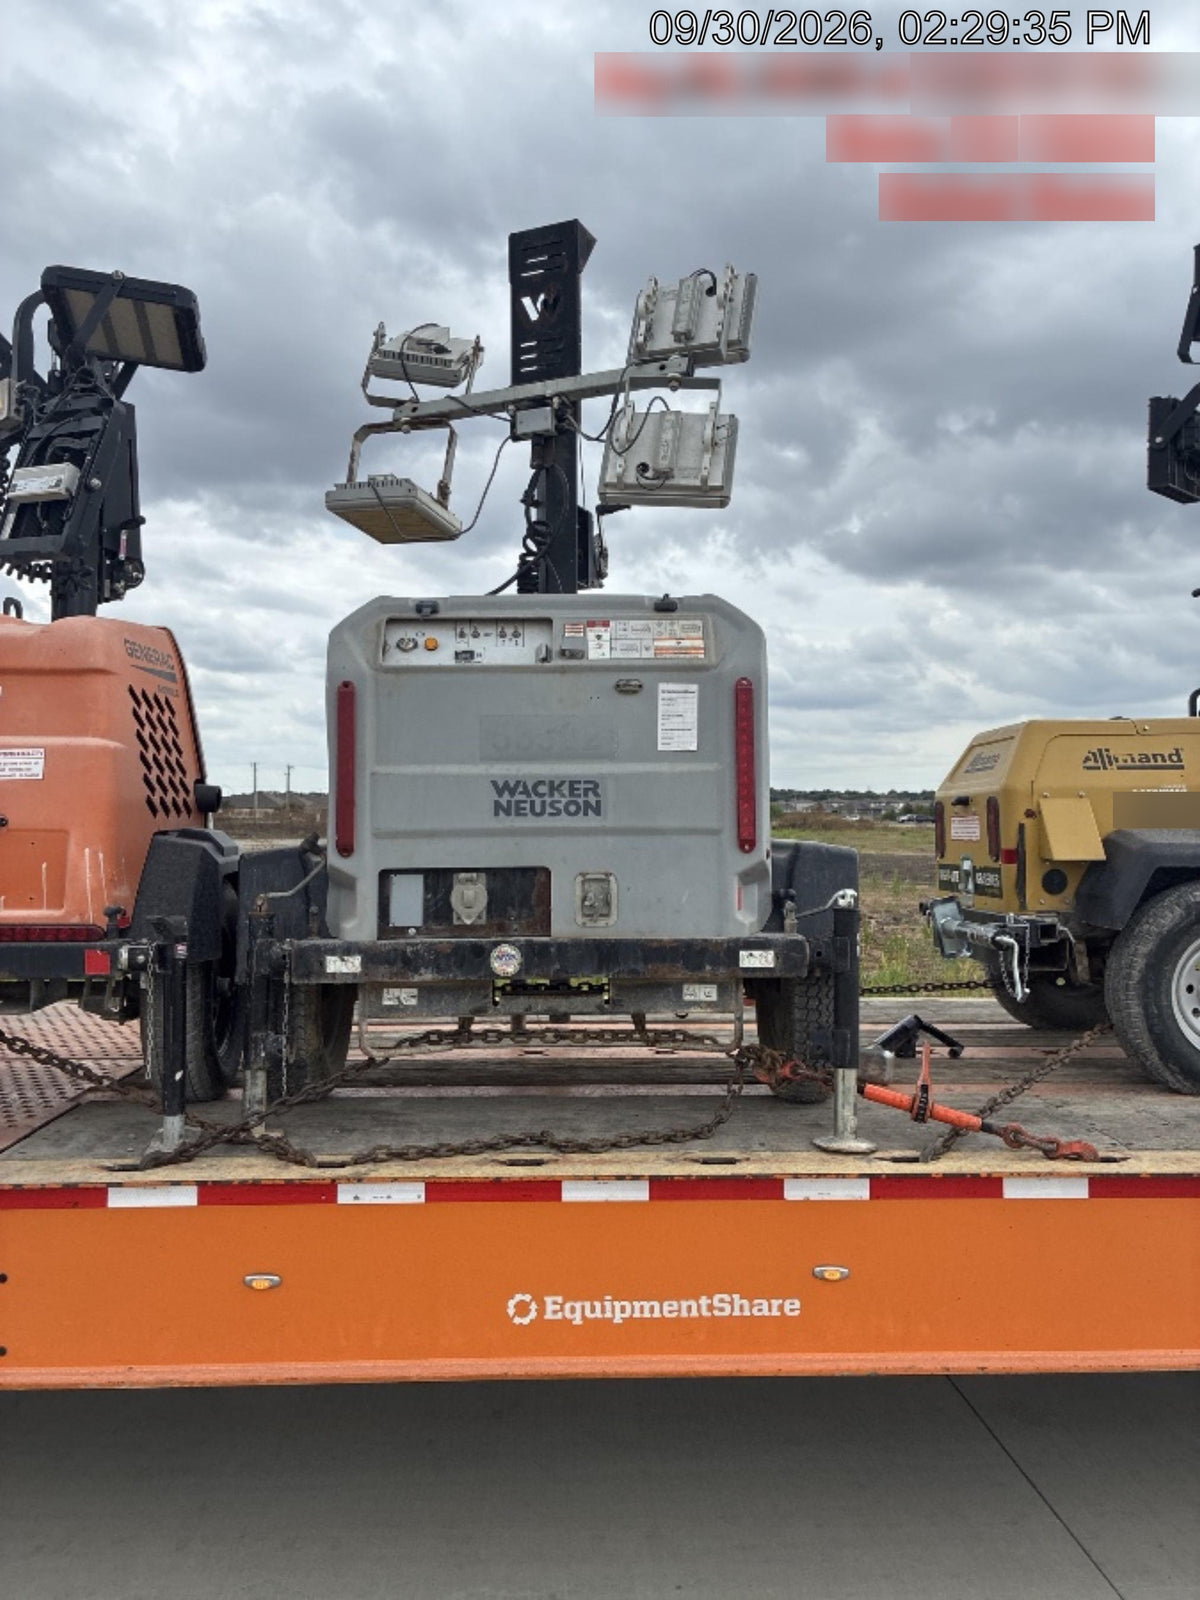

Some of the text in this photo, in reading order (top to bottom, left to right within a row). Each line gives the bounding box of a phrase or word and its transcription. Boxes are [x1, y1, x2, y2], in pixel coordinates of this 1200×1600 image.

[490, 780, 601, 799] WACKER
[494, 800, 602, 817] NEUSON
[543, 1294, 801, 1325] EquipmentShare
